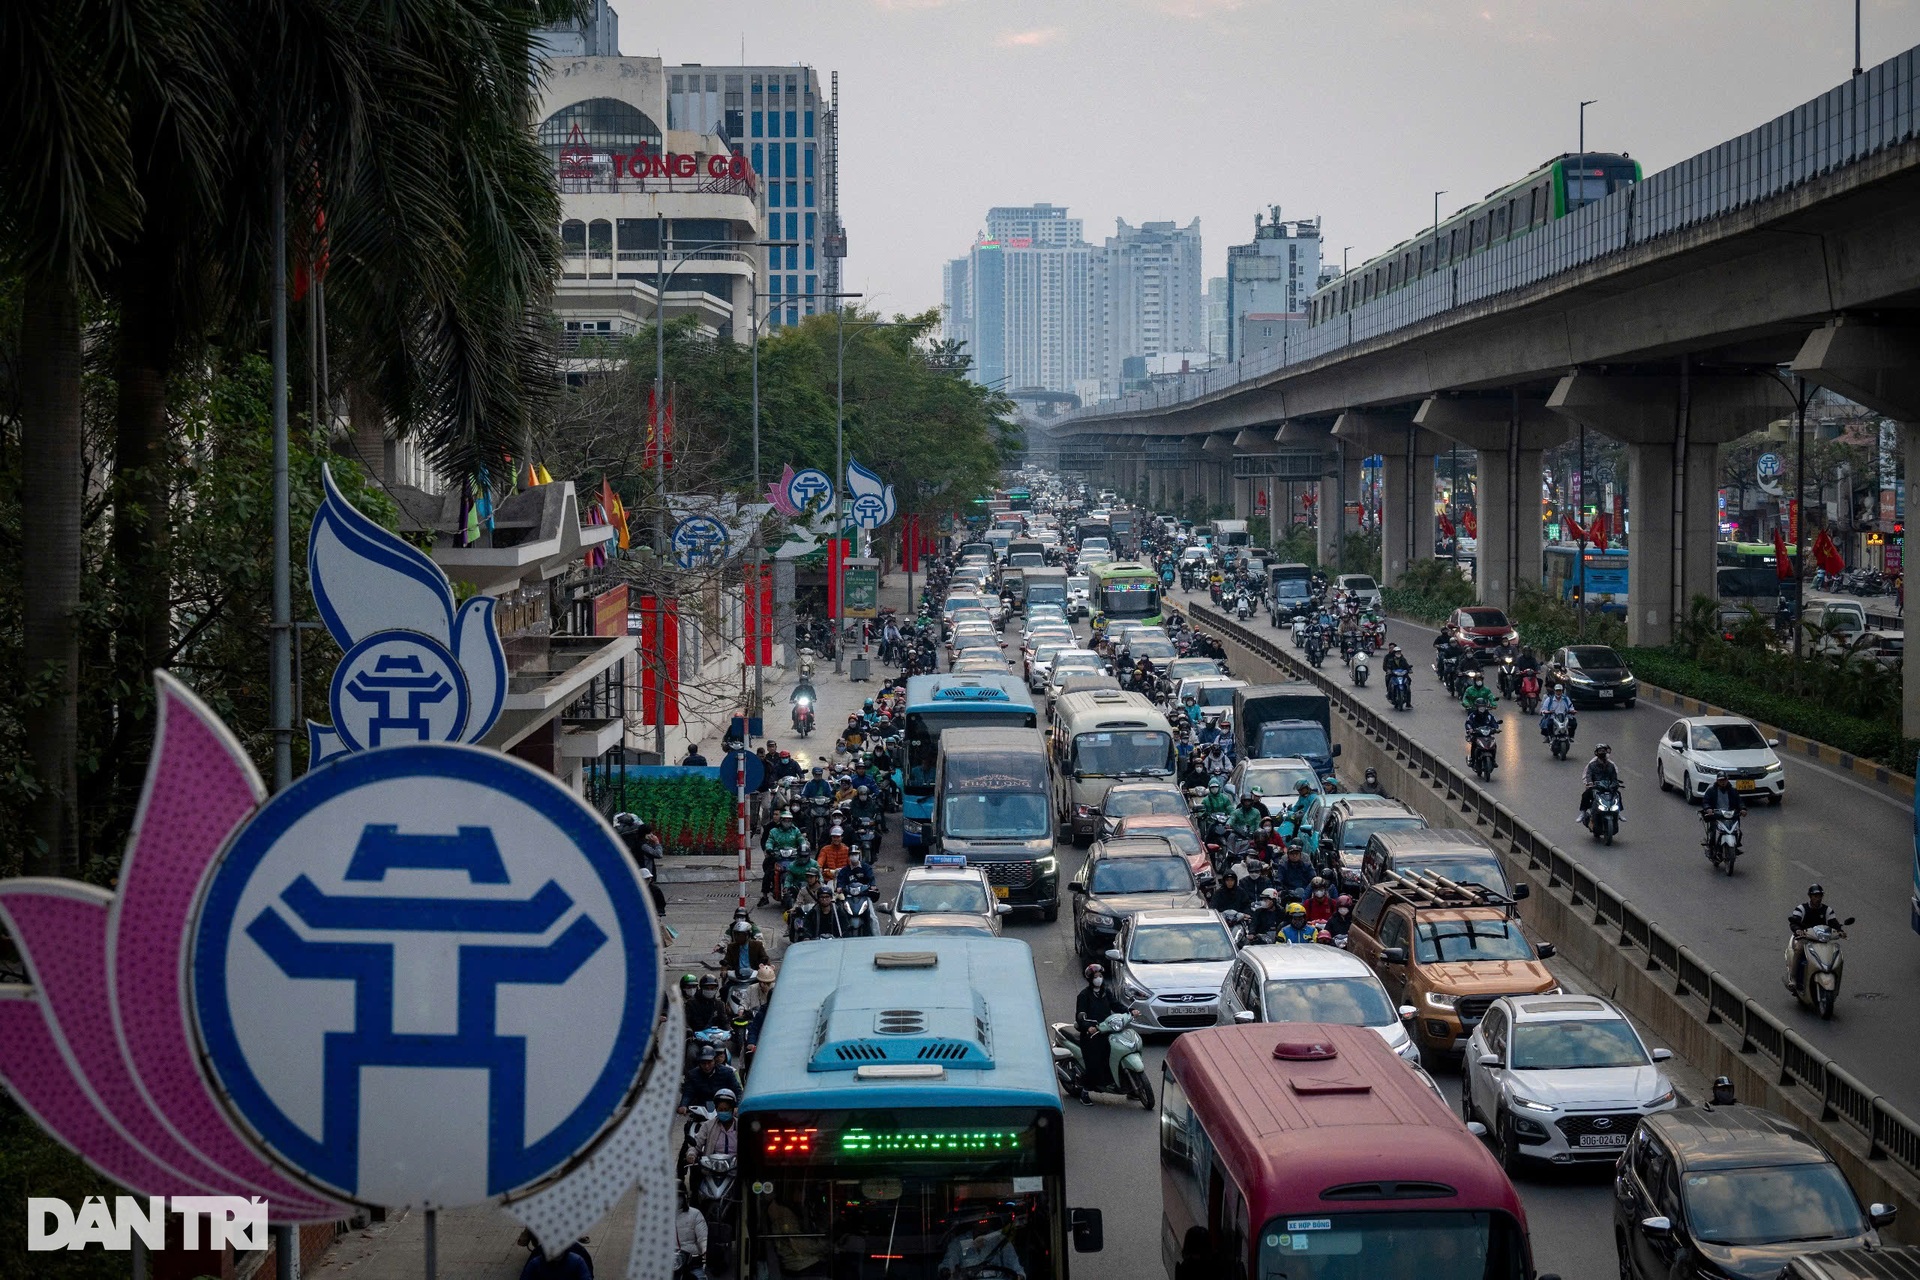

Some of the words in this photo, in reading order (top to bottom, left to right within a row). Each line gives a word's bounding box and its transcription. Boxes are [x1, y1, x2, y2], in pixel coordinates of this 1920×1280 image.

[612, 140, 697, 179] TỔNG
[1581, 1135, 1626, 1145] 30G-024.67
[1288, 1221, 1297, 1229] XE
